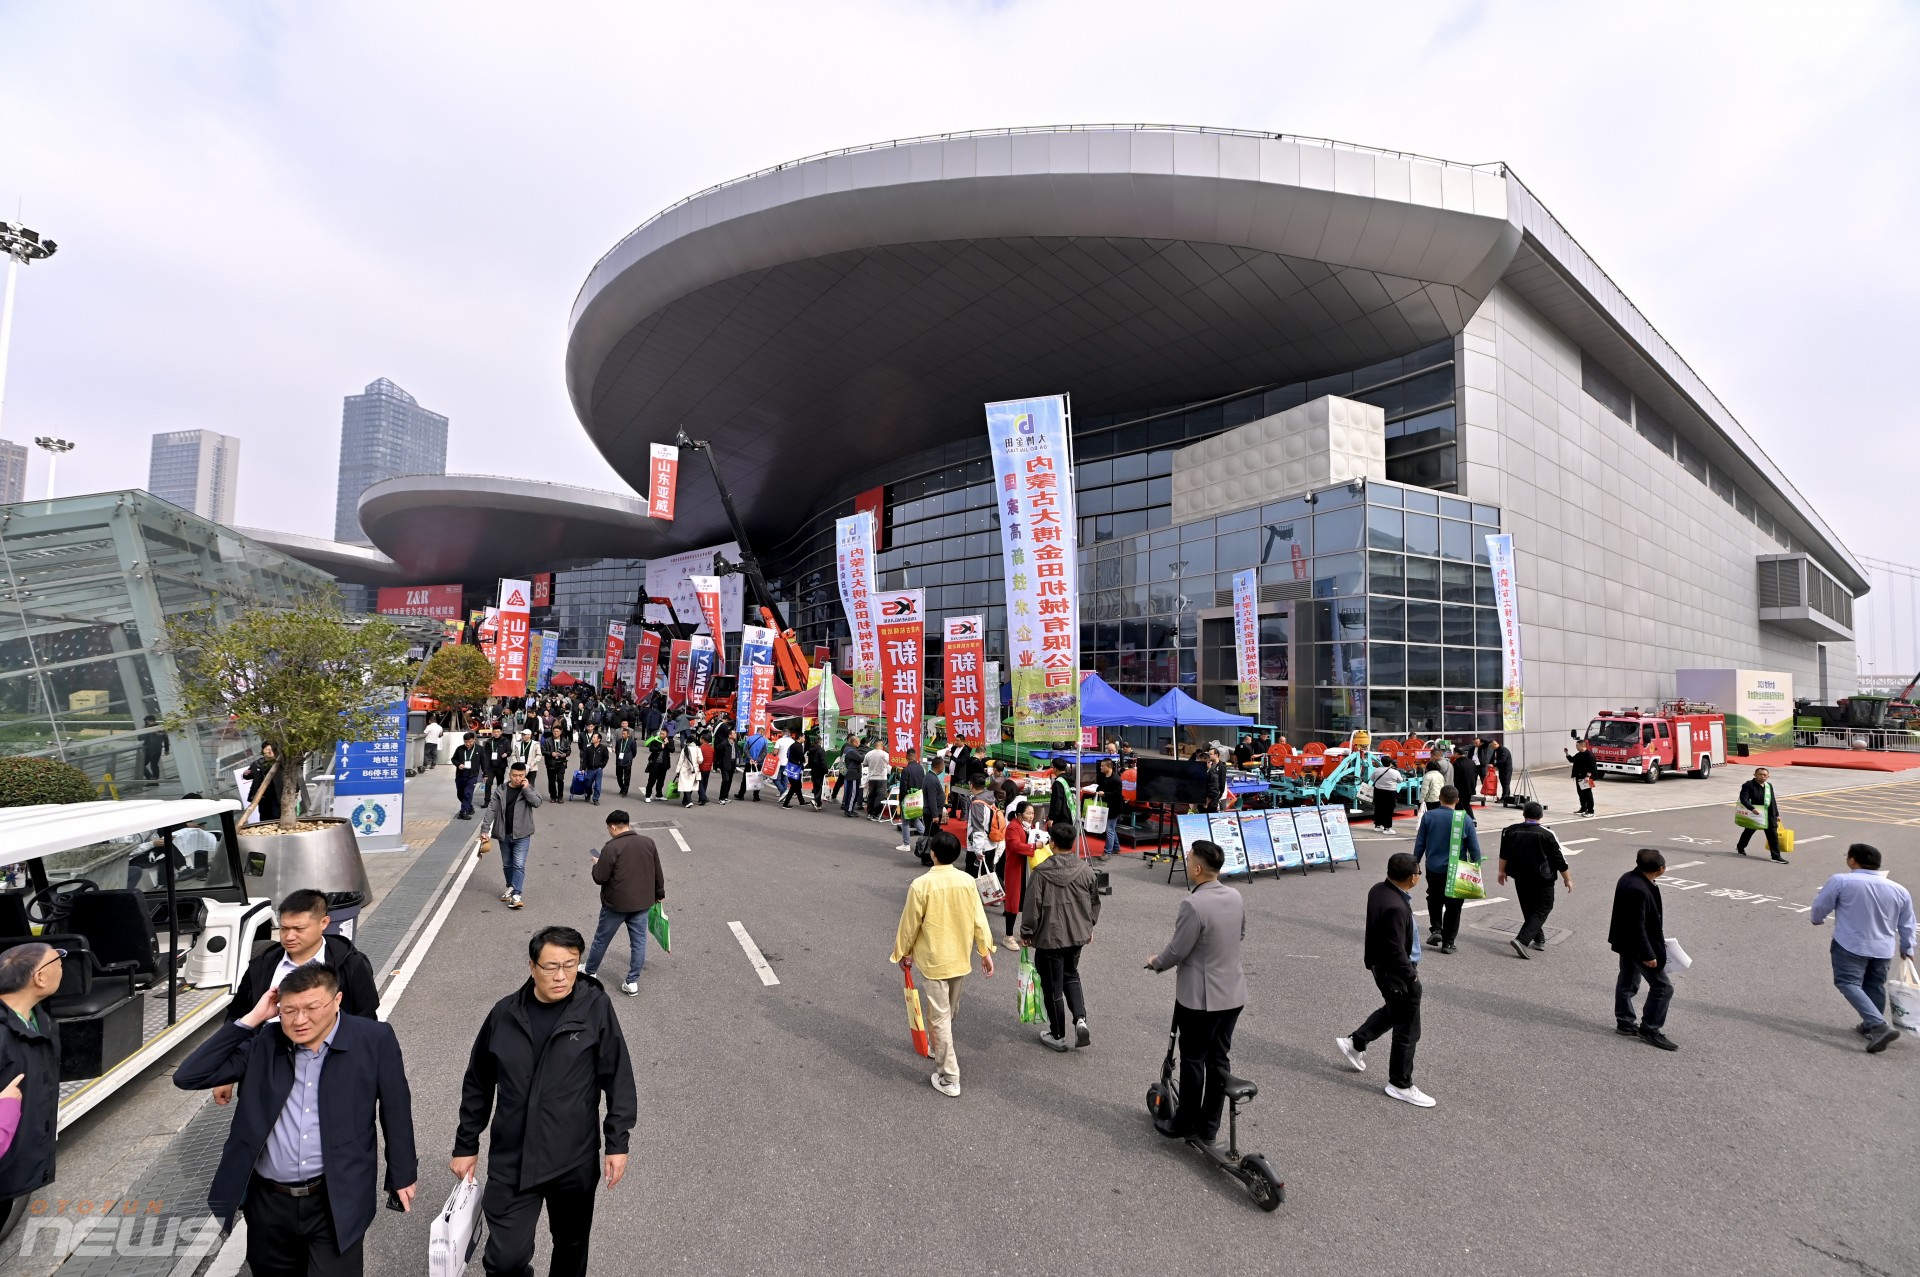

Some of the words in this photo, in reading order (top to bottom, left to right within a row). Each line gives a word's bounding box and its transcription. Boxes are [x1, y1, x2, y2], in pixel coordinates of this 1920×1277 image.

[655, 460, 671, 513] 山东亚威
[406, 590, 430, 605] Z&R
[535, 581, 548, 598] B5
[501, 619, 509, 651] SHAN
[505, 618, 527, 682] 山叉重工
[498, 656, 507, 680] CHA
[694, 654, 710, 705] YAWEH
[373, 742, 399, 750] 交通港
[372, 755, 399, 764] 地铁站
[362, 768, 398, 777] B6停车区
